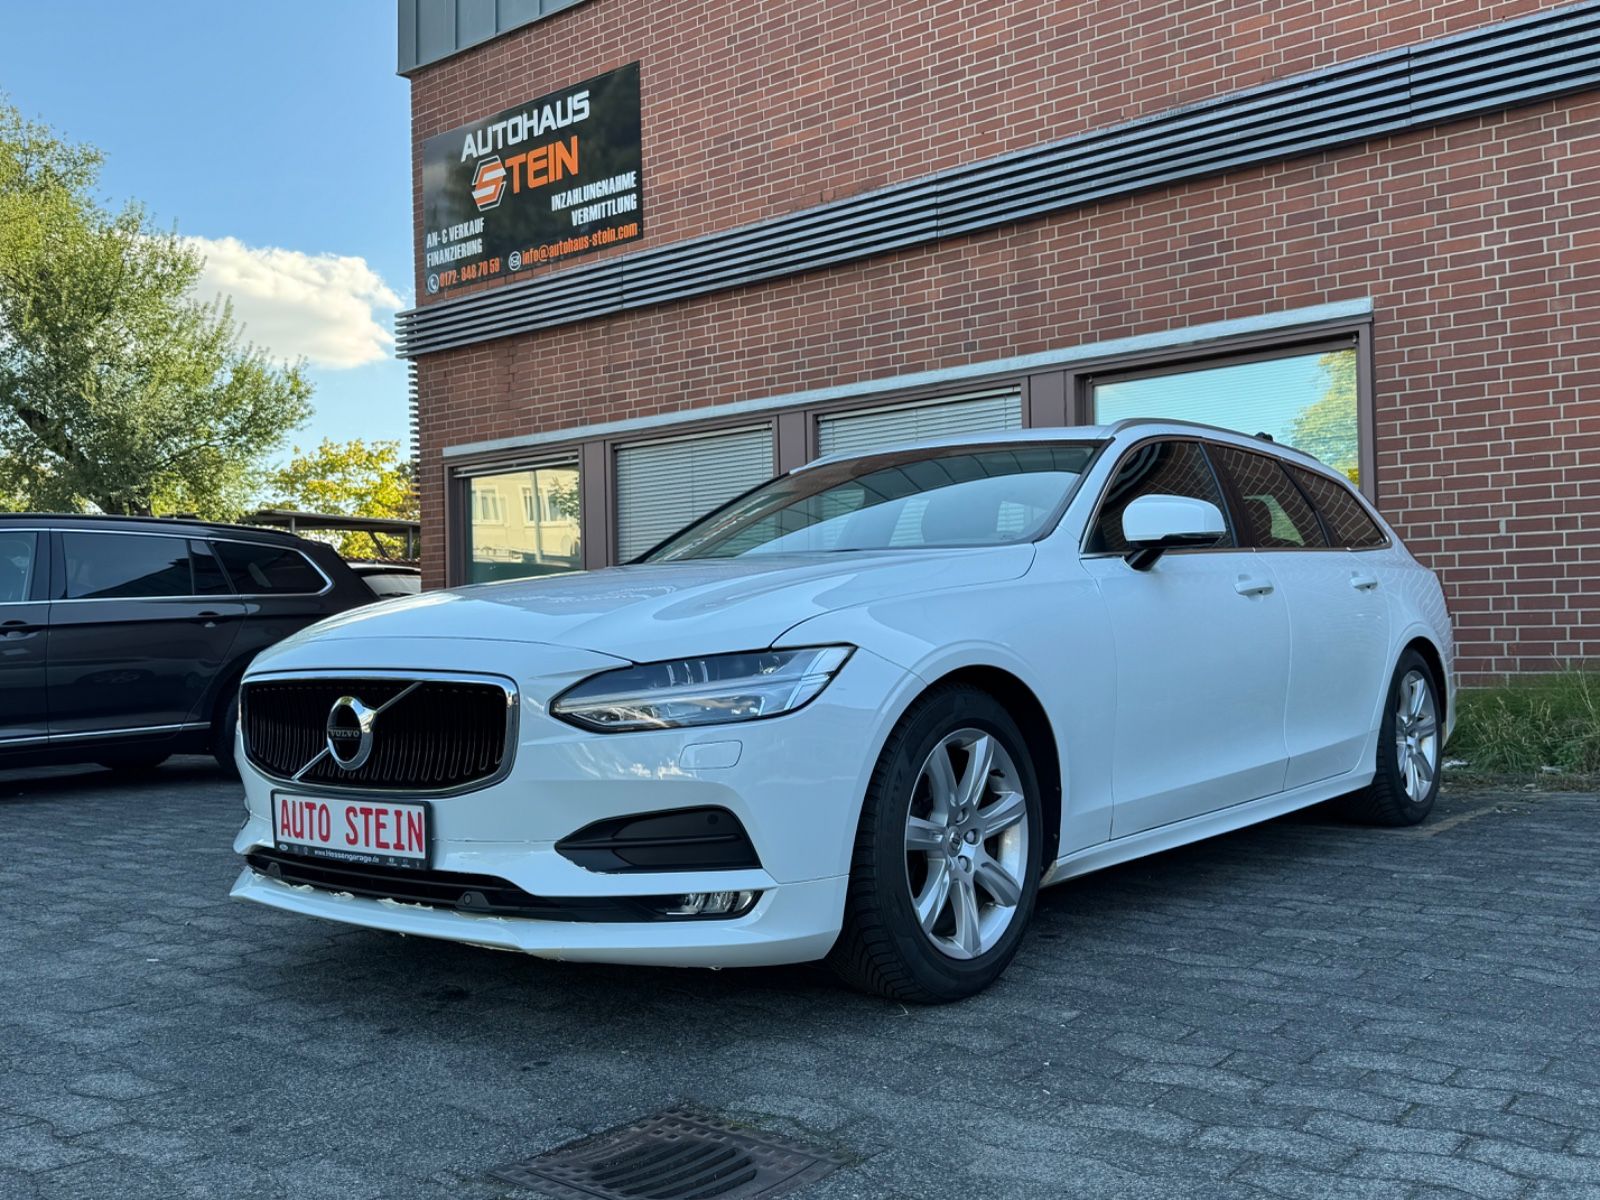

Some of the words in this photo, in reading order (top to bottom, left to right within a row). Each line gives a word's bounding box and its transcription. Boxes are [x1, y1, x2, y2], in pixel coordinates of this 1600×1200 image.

[461, 90, 590, 162] AUTOHAUS
[472, 135, 579, 208] STEIN
[551, 171, 637, 212] INZAHLUNGNAHME
[448, 217, 485, 242] VERKAUF
[571, 193, 637, 227] VERMITTLUNG
[427, 238, 483, 268] FINANZIERUNG
[521, 222, 638, 265] info@autohaus-stein.com
[330, 729, 360, 737] VOLVO
[281, 799, 331, 842] AUTO
[345, 805, 423, 853] STEIN
